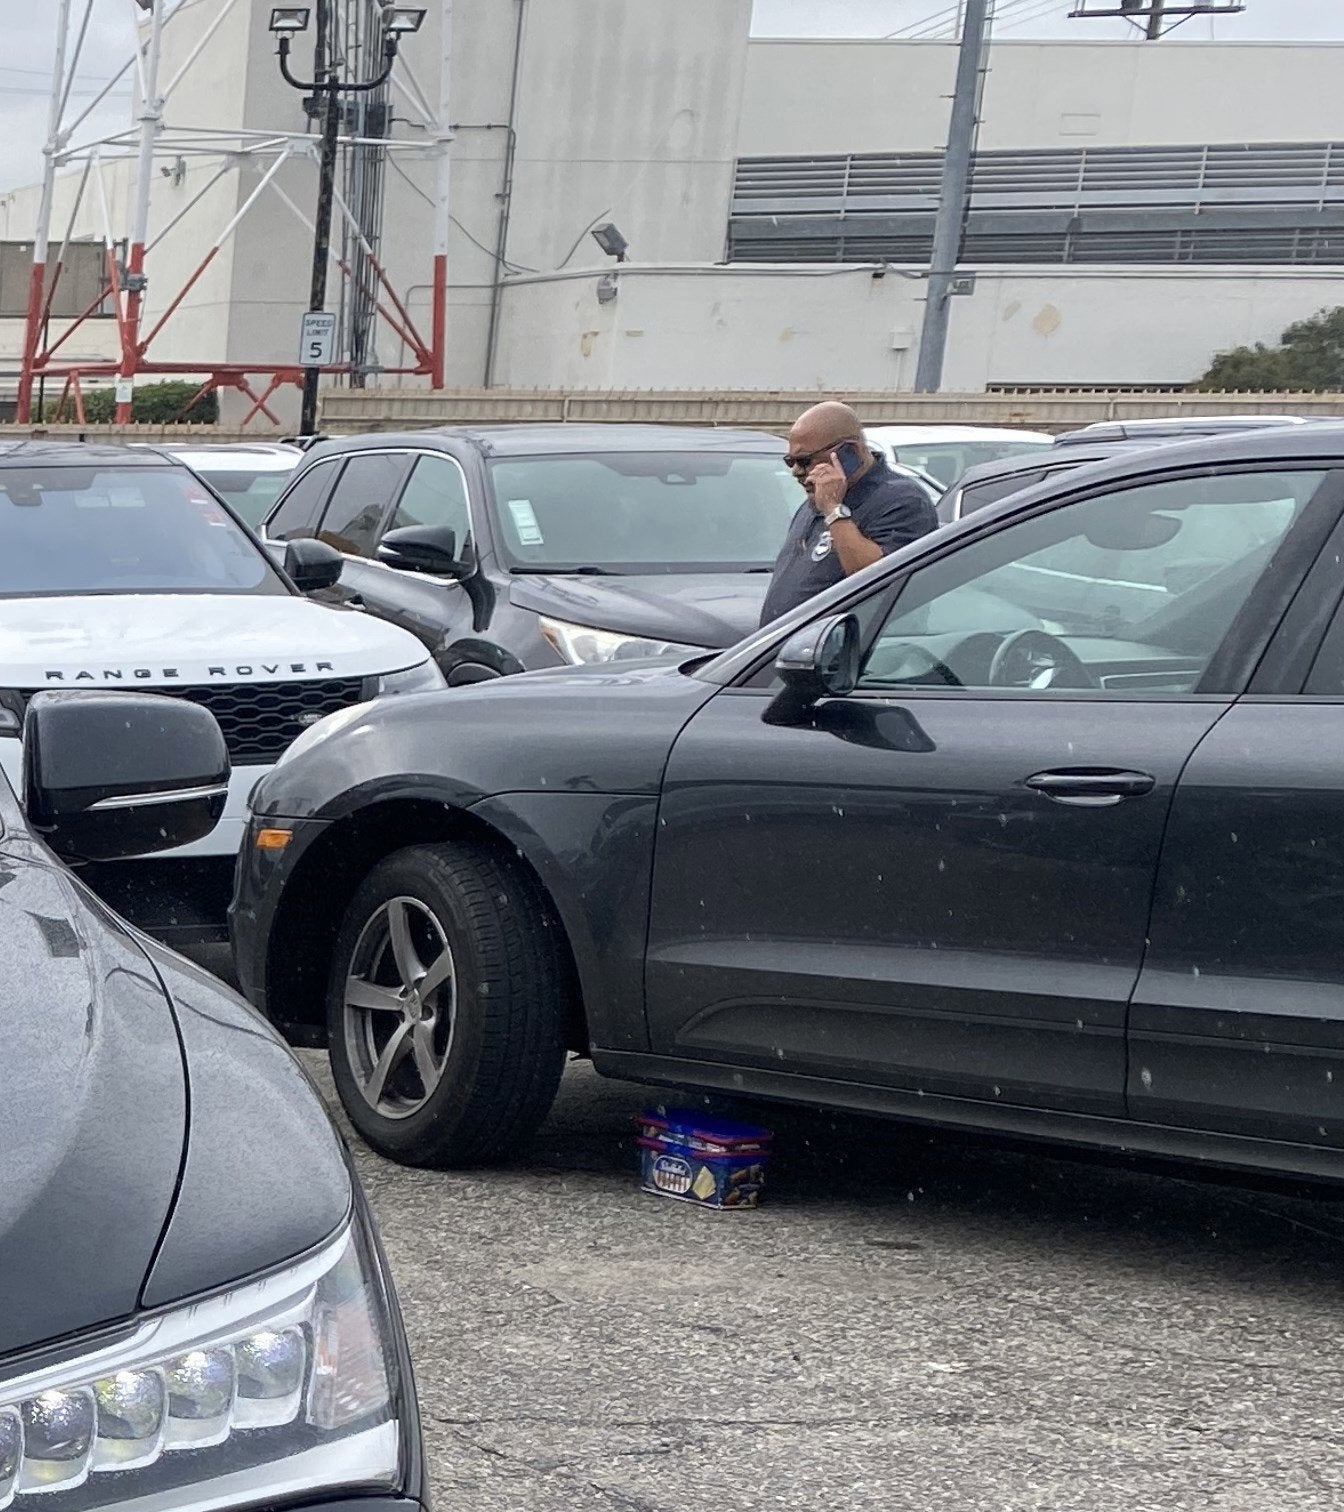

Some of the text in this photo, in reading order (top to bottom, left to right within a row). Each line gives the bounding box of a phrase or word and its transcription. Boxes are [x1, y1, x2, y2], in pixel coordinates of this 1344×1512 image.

[305, 319, 333, 327] SPEED
[310, 342, 322, 358] 5
[45, 661, 334, 681] RANGE ROVER
